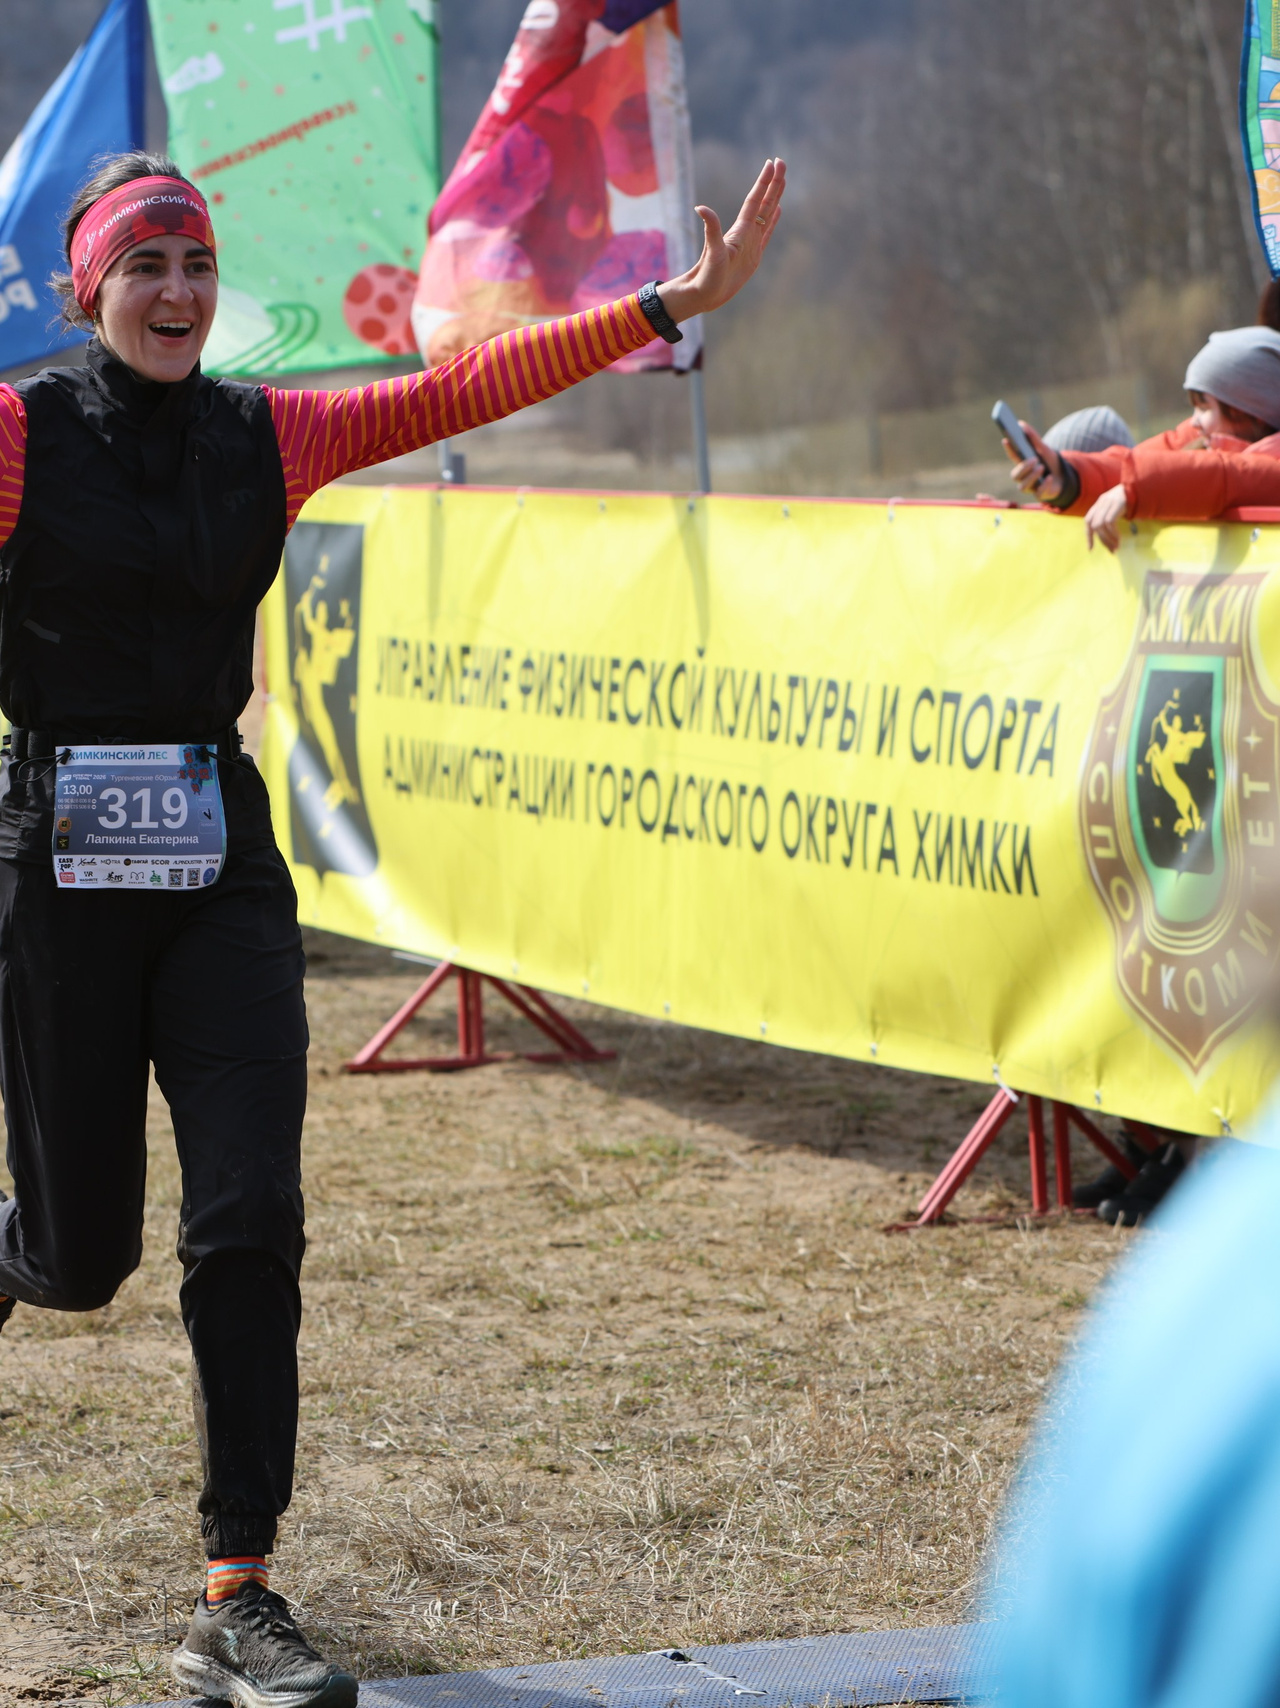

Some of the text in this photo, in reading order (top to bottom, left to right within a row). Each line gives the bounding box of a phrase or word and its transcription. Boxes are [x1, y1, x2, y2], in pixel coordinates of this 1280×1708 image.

[98, 194, 187, 237] #ХИМКИНСКИЙ
[375, 635, 1061, 778] УПРАВЛЕНИЕ ФИЗИЧЕСКОЙ КУЛЬТУРЫ И СПОРТА
[147, 751, 168, 760] ЛЕС
[63, 784, 93, 797] 13,00
[97, 787, 188, 830] 319
[382, 733, 1039, 898] АДМИНИСТРАЦИИ ГОРОДСКОГО ОКРУГА ХИМКИ
[85, 833, 199, 846] Лапкина Екатерина
[150, 858, 170, 866] SCOR
